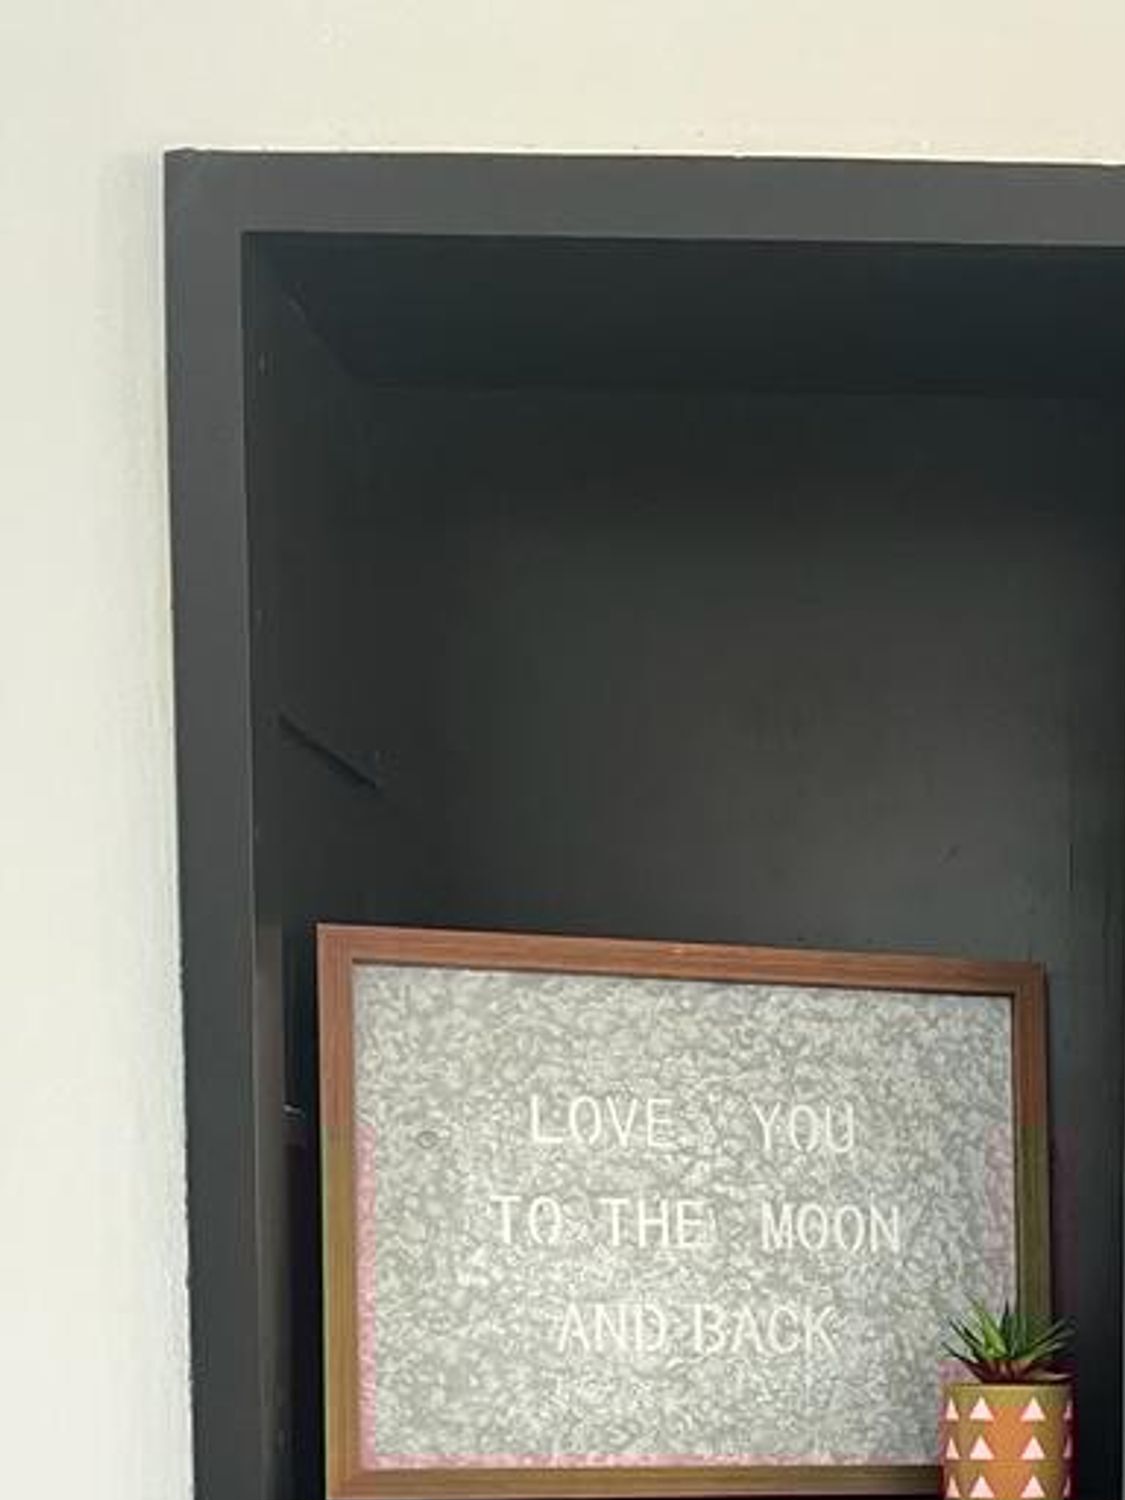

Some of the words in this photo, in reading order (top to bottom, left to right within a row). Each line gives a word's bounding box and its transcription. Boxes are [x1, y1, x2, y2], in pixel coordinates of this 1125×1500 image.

[530, 1094, 674, 1148] LOVE
[752, 1101, 855, 1153] YOU
[490, 1194, 562, 1246] TO
[599, 1197, 702, 1249] THE
[760, 1202, 901, 1254] MOON
[557, 1302, 668, 1353] AND
[693, 1304, 838, 1357] BACK
